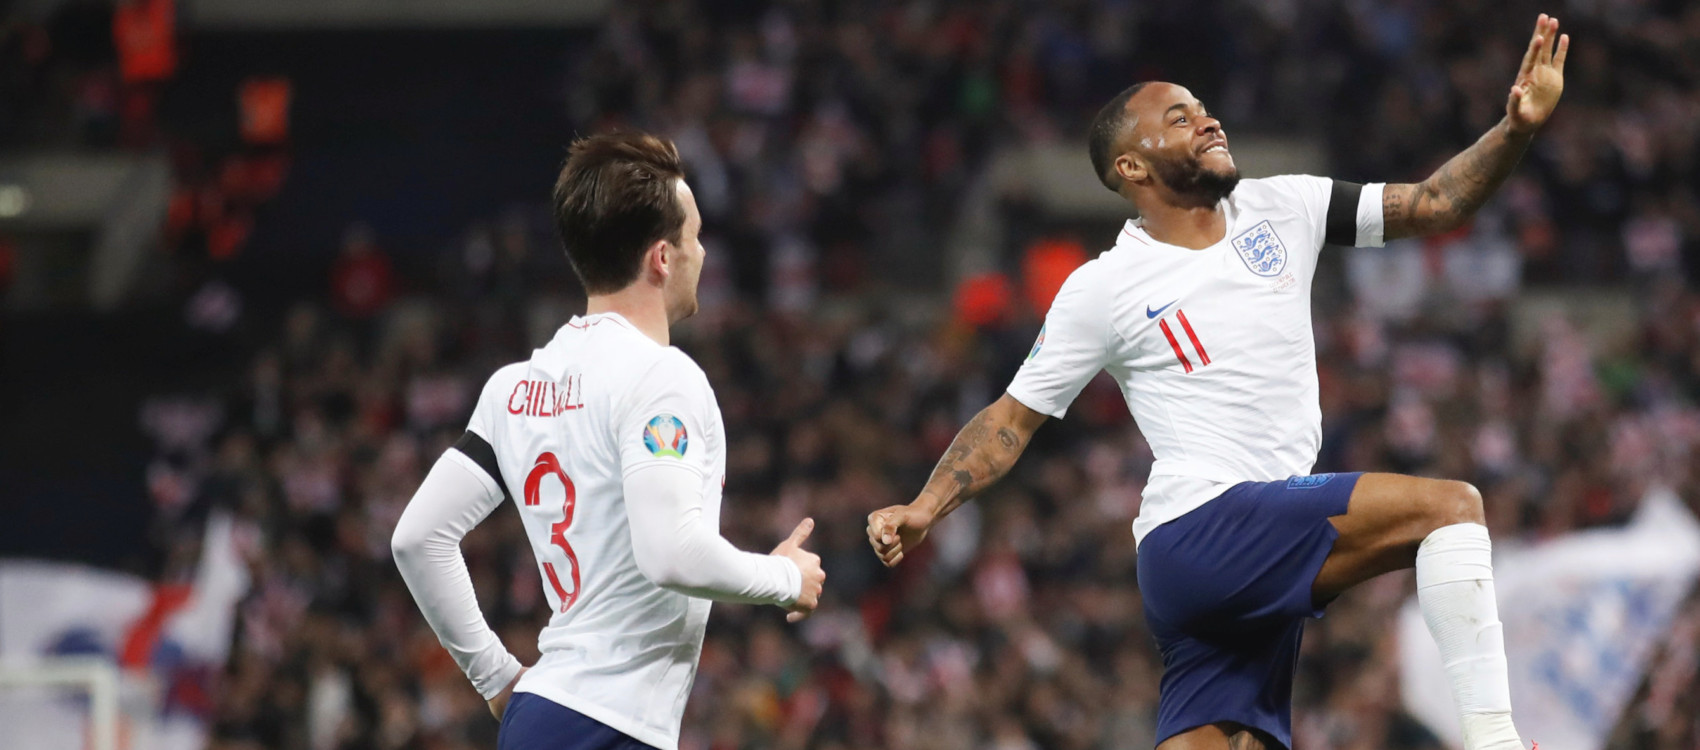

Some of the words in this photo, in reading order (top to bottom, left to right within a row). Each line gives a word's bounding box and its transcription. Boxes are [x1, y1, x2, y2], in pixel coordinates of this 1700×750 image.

[1159, 309, 1211, 374] 11
[508, 373, 584, 417] CHILWLL
[524, 452, 581, 613] 3
